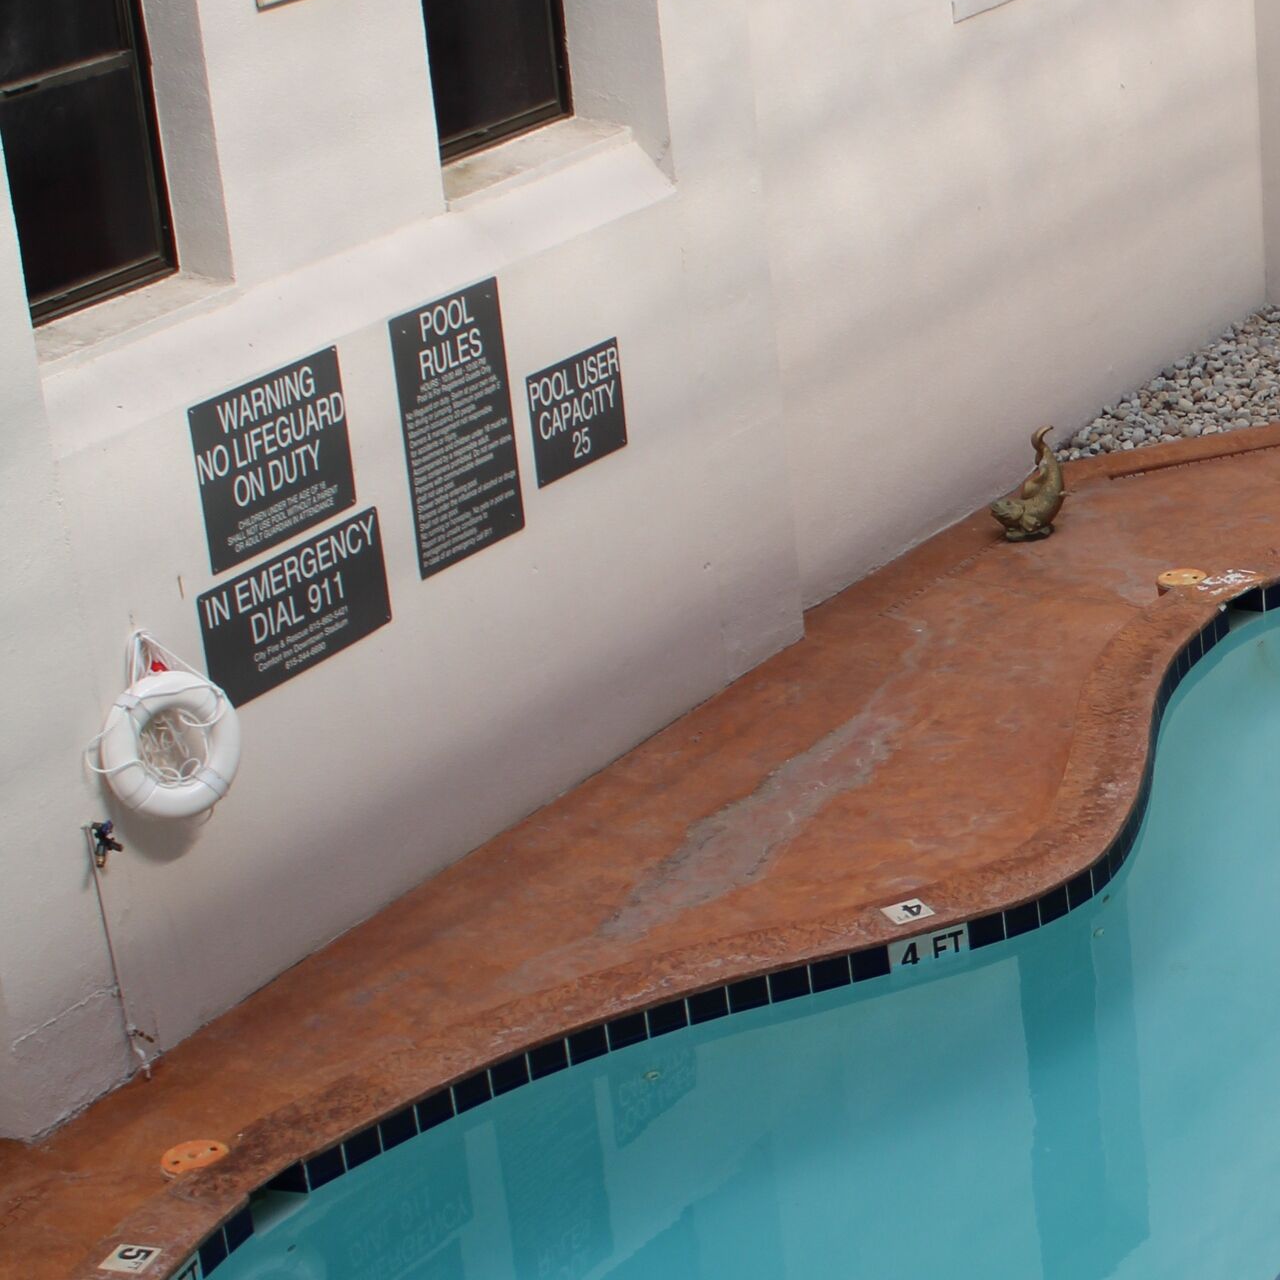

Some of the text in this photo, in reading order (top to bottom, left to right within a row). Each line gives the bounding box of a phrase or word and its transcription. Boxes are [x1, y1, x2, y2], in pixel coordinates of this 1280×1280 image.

[420, 297, 474, 342] POOL
[419, 328, 483, 380] RULES
[217, 366, 316, 433] WARNING
[529, 370, 574, 412] POOL
[576, 347, 619, 388] USER
[539, 380, 615, 440] CAPACITY
[197, 445, 229, 485] NO
[234, 392, 345, 468] LIFEGUARD
[572, 427, 591, 459] 25
[234, 440, 320, 507] ON DUTY
[227, 528, 246, 547] SHALL
[245, 522, 258, 537] NOT
[258, 516, 271, 531] USE
[271, 508, 287, 525] POOL
[237, 508, 266, 531] CHILDREN
[266, 498, 287, 516] UNDER
[286, 493, 298, 507] THE
[298, 487, 310, 501] AGE
[310, 482, 319, 495] OF
[234, 539, 245, 554] OR
[244, 530, 264, 549] ADULT
[205, 591, 230, 629] IN
[235, 516, 374, 613] EMERGENCY
[250, 571, 344, 645] DIAL 911
[253, 648, 266, 663] City
[278, 638, 285, 649] &
[902, 904, 922, 917] 4
[901, 930, 964, 965] 4 FT
[117, 1247, 154, 1261] 5
